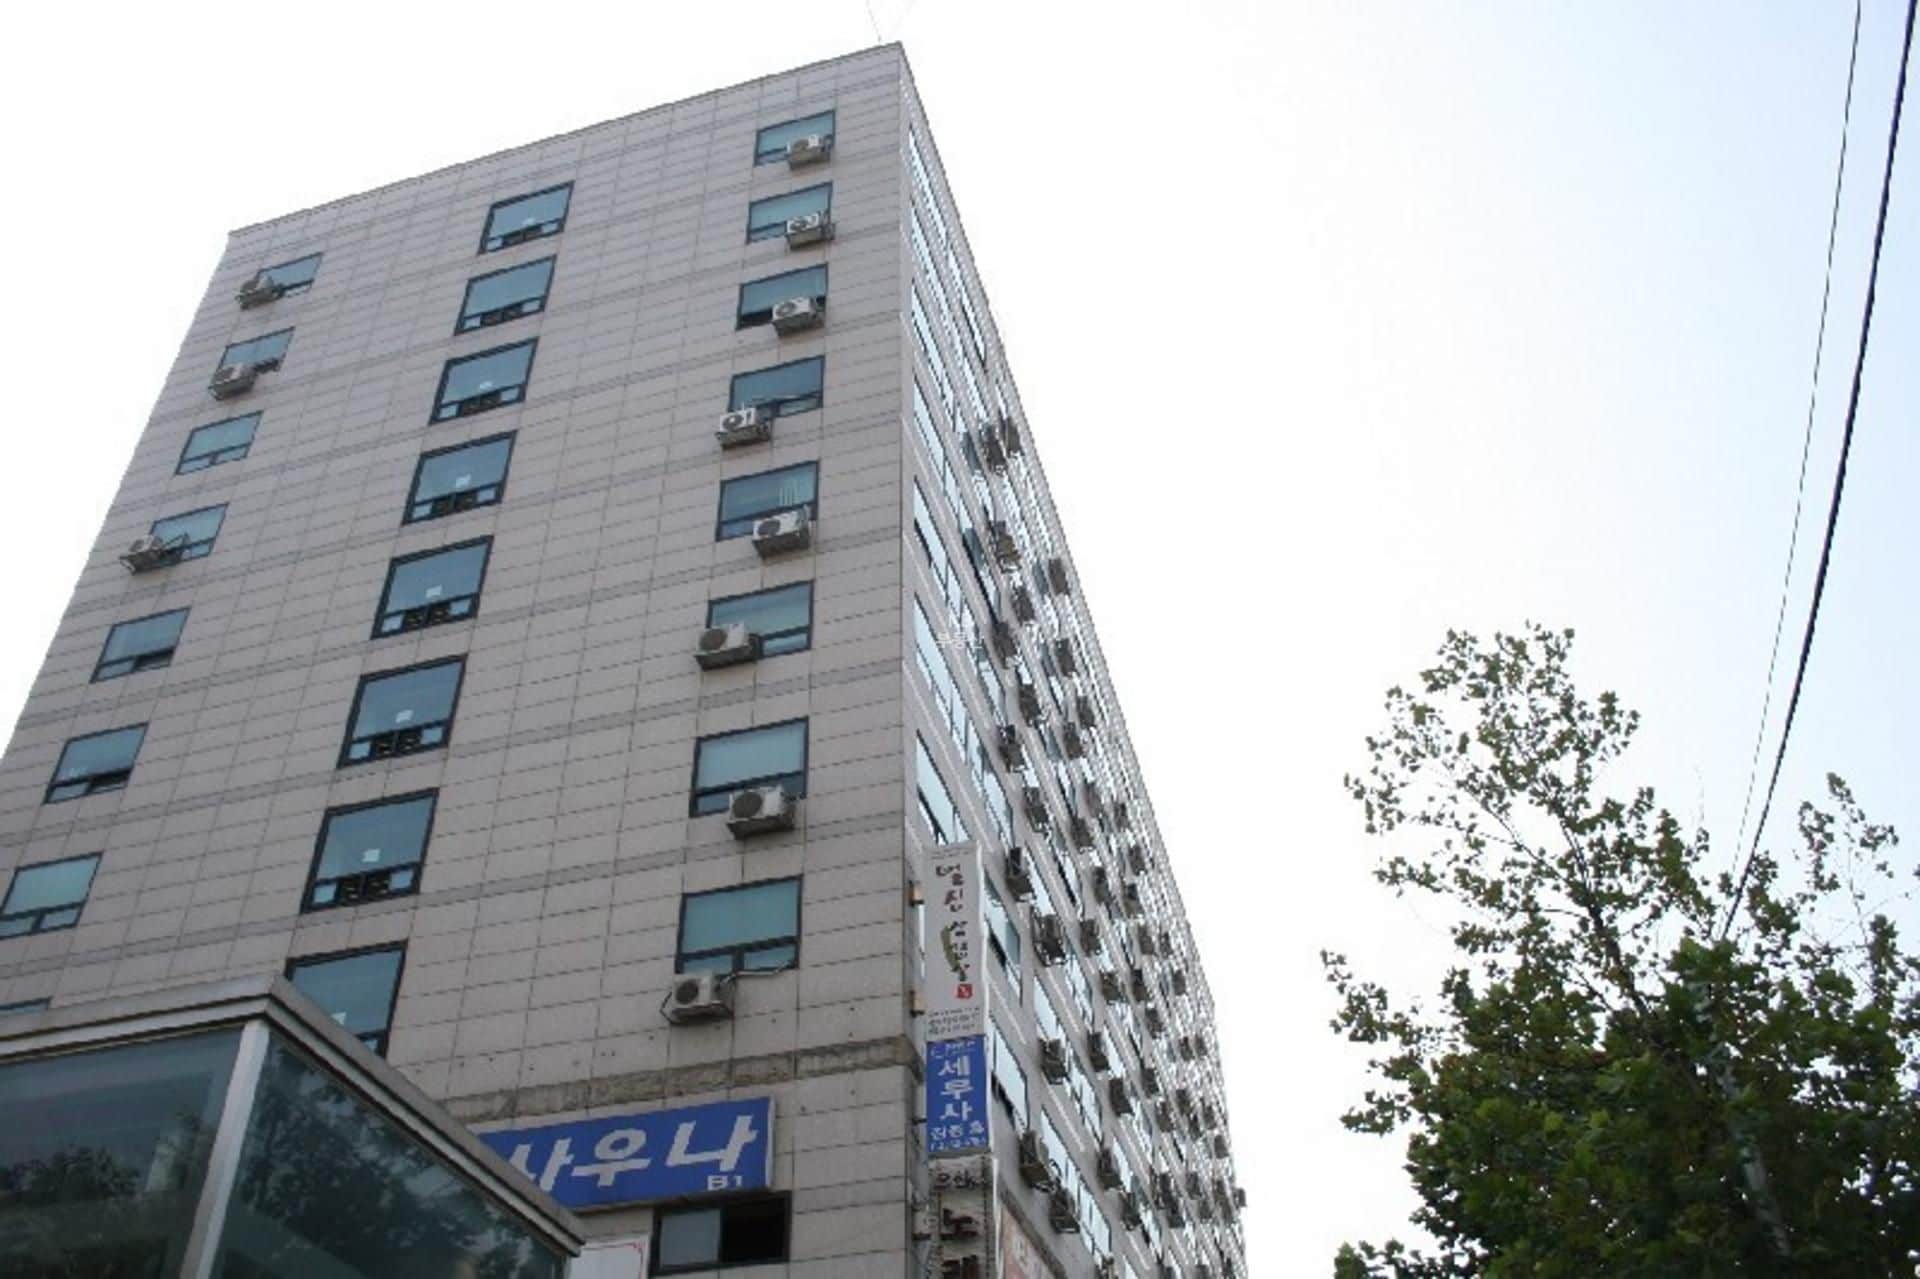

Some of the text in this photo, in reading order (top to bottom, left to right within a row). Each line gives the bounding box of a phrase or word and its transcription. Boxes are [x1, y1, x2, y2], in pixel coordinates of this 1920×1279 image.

[937, 1054, 975, 1121] 세무사
[508, 1114, 758, 1191] 사우나
[707, 1175, 744, 1191] B1
